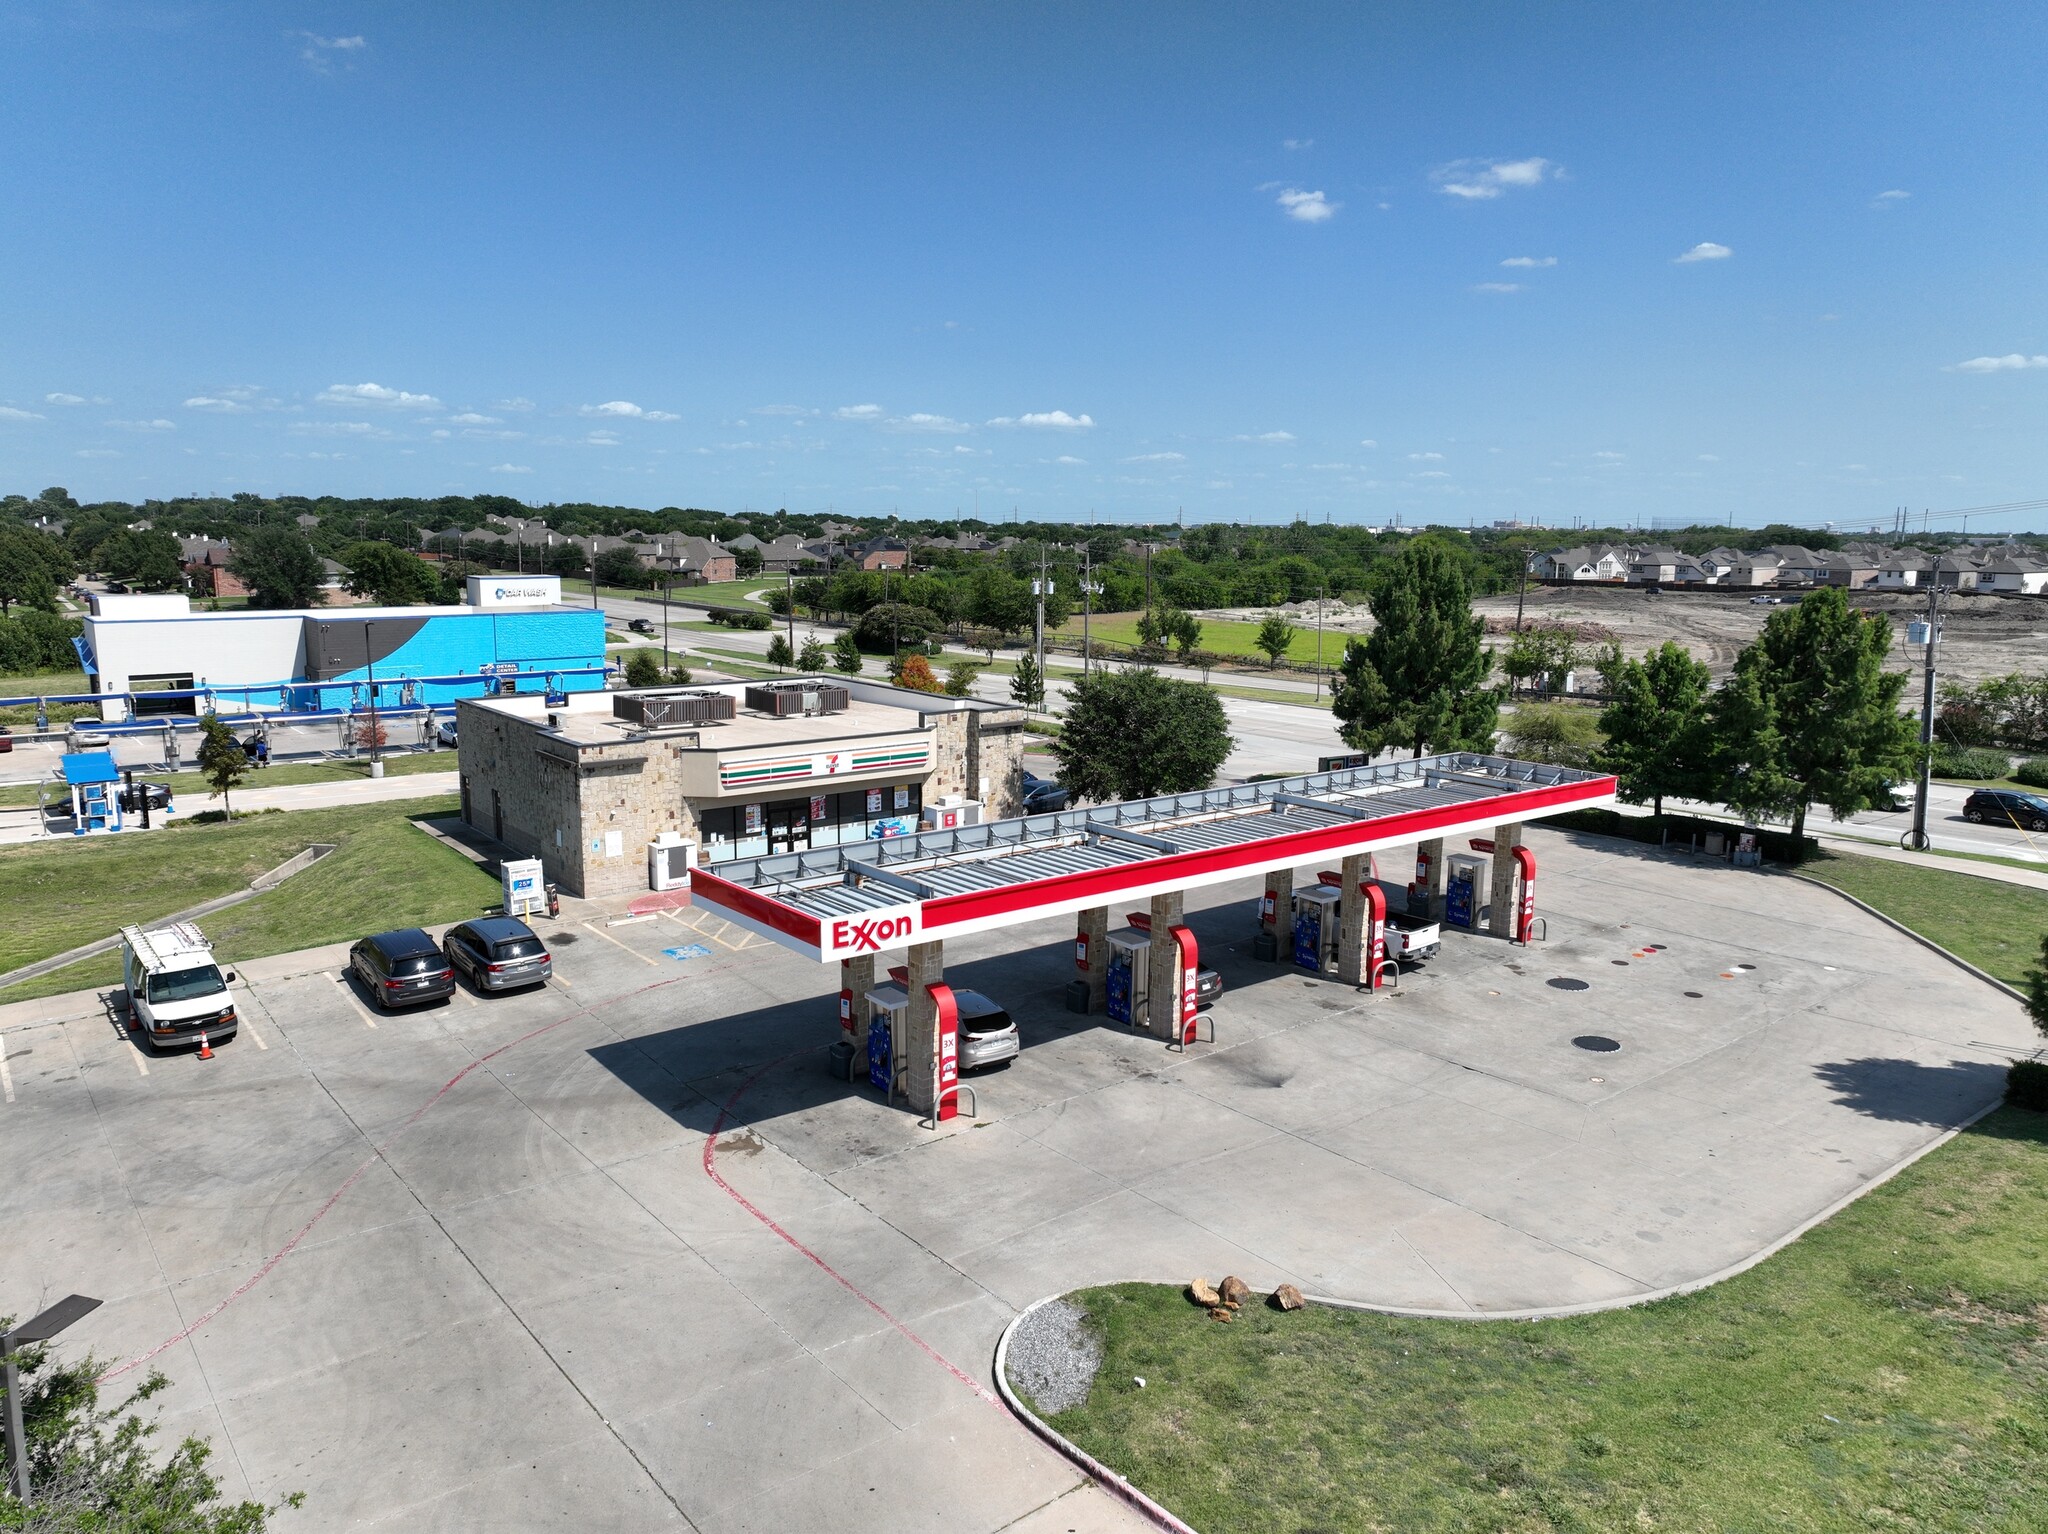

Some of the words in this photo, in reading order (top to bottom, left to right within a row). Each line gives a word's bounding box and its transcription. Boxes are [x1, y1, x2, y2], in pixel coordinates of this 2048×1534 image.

[505, 588, 521, 598] CAR
[523, 588, 547, 597] WASH
[833, 916, 912, 952] Exxon
[943, 1038, 954, 1049] 3X
